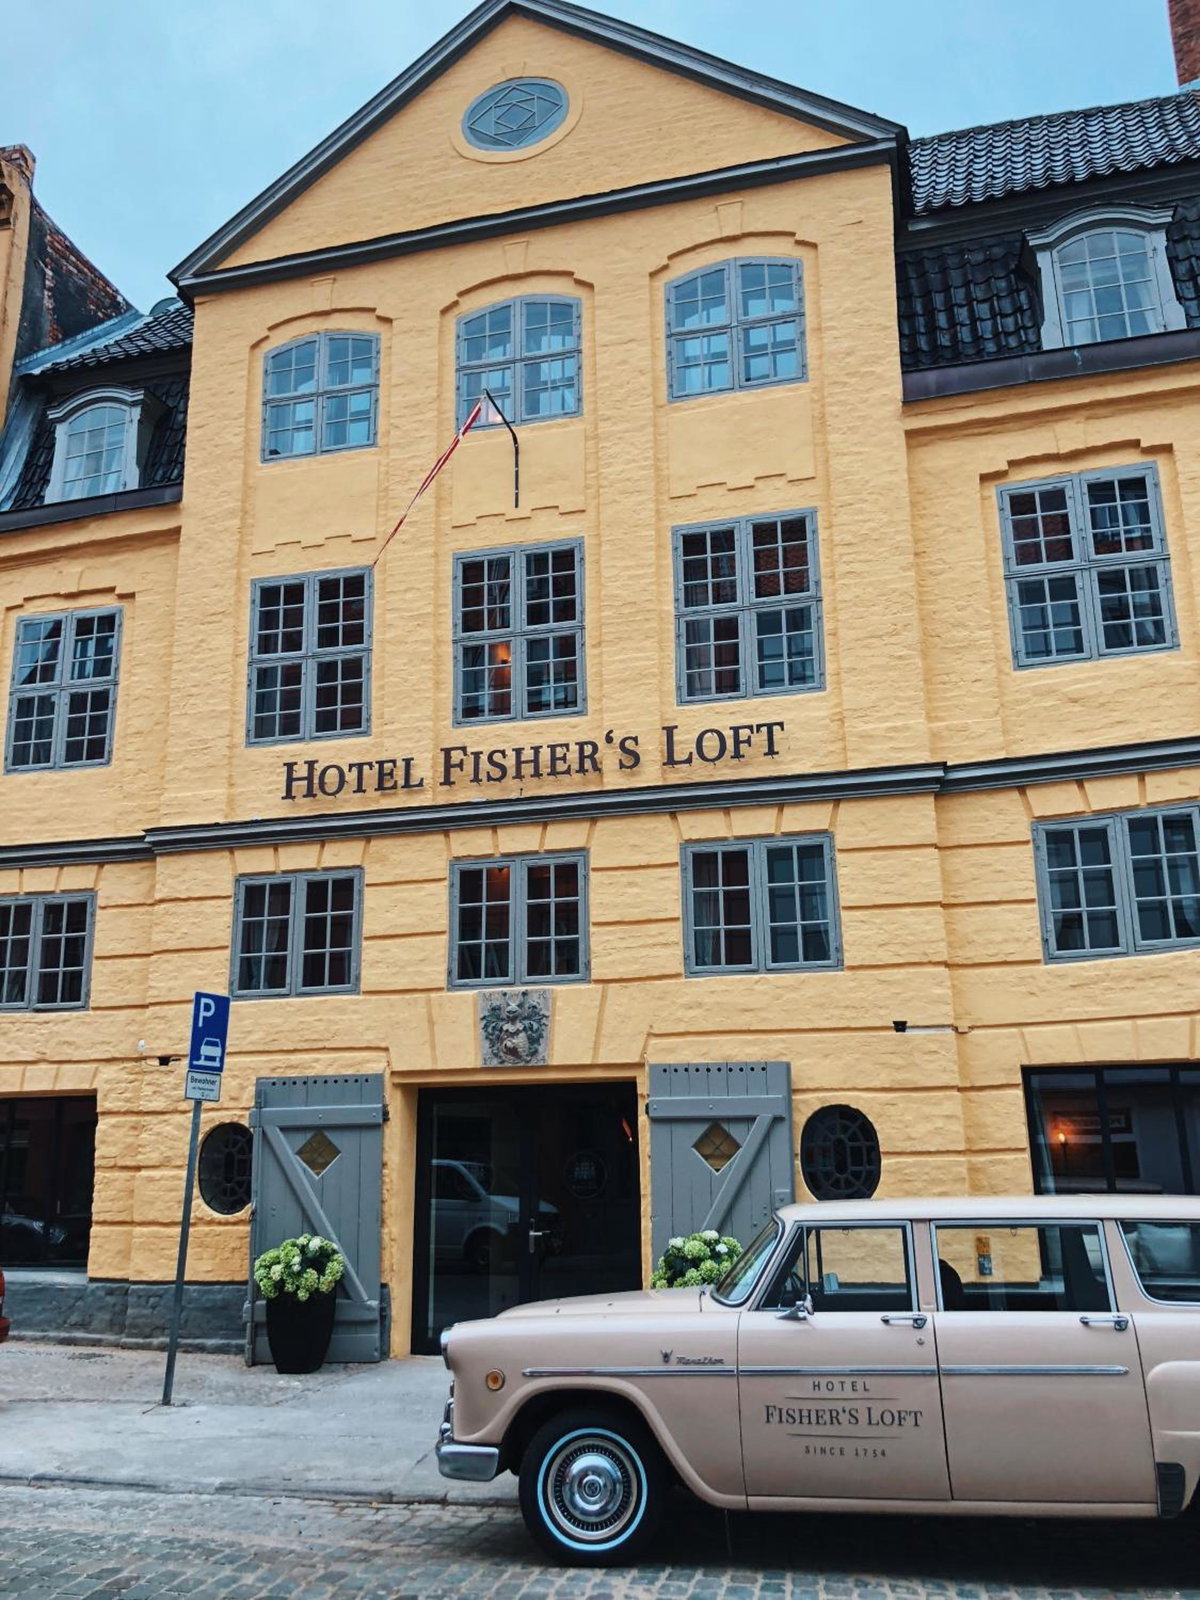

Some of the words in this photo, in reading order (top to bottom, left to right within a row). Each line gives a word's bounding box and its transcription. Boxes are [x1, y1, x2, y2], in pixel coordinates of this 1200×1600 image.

[281, 756, 424, 800] HOTEL
[439, 729, 642, 786] FISHER'S
[661, 721, 785, 768] LOFT
[198, 997, 215, 1028] P
[813, 1381, 869, 1392] HOTEL
[765, 1404, 859, 1426] FISHER'S
[867, 1406, 922, 1427] LOFT
[805, 1445, 845, 1456] SINCE
